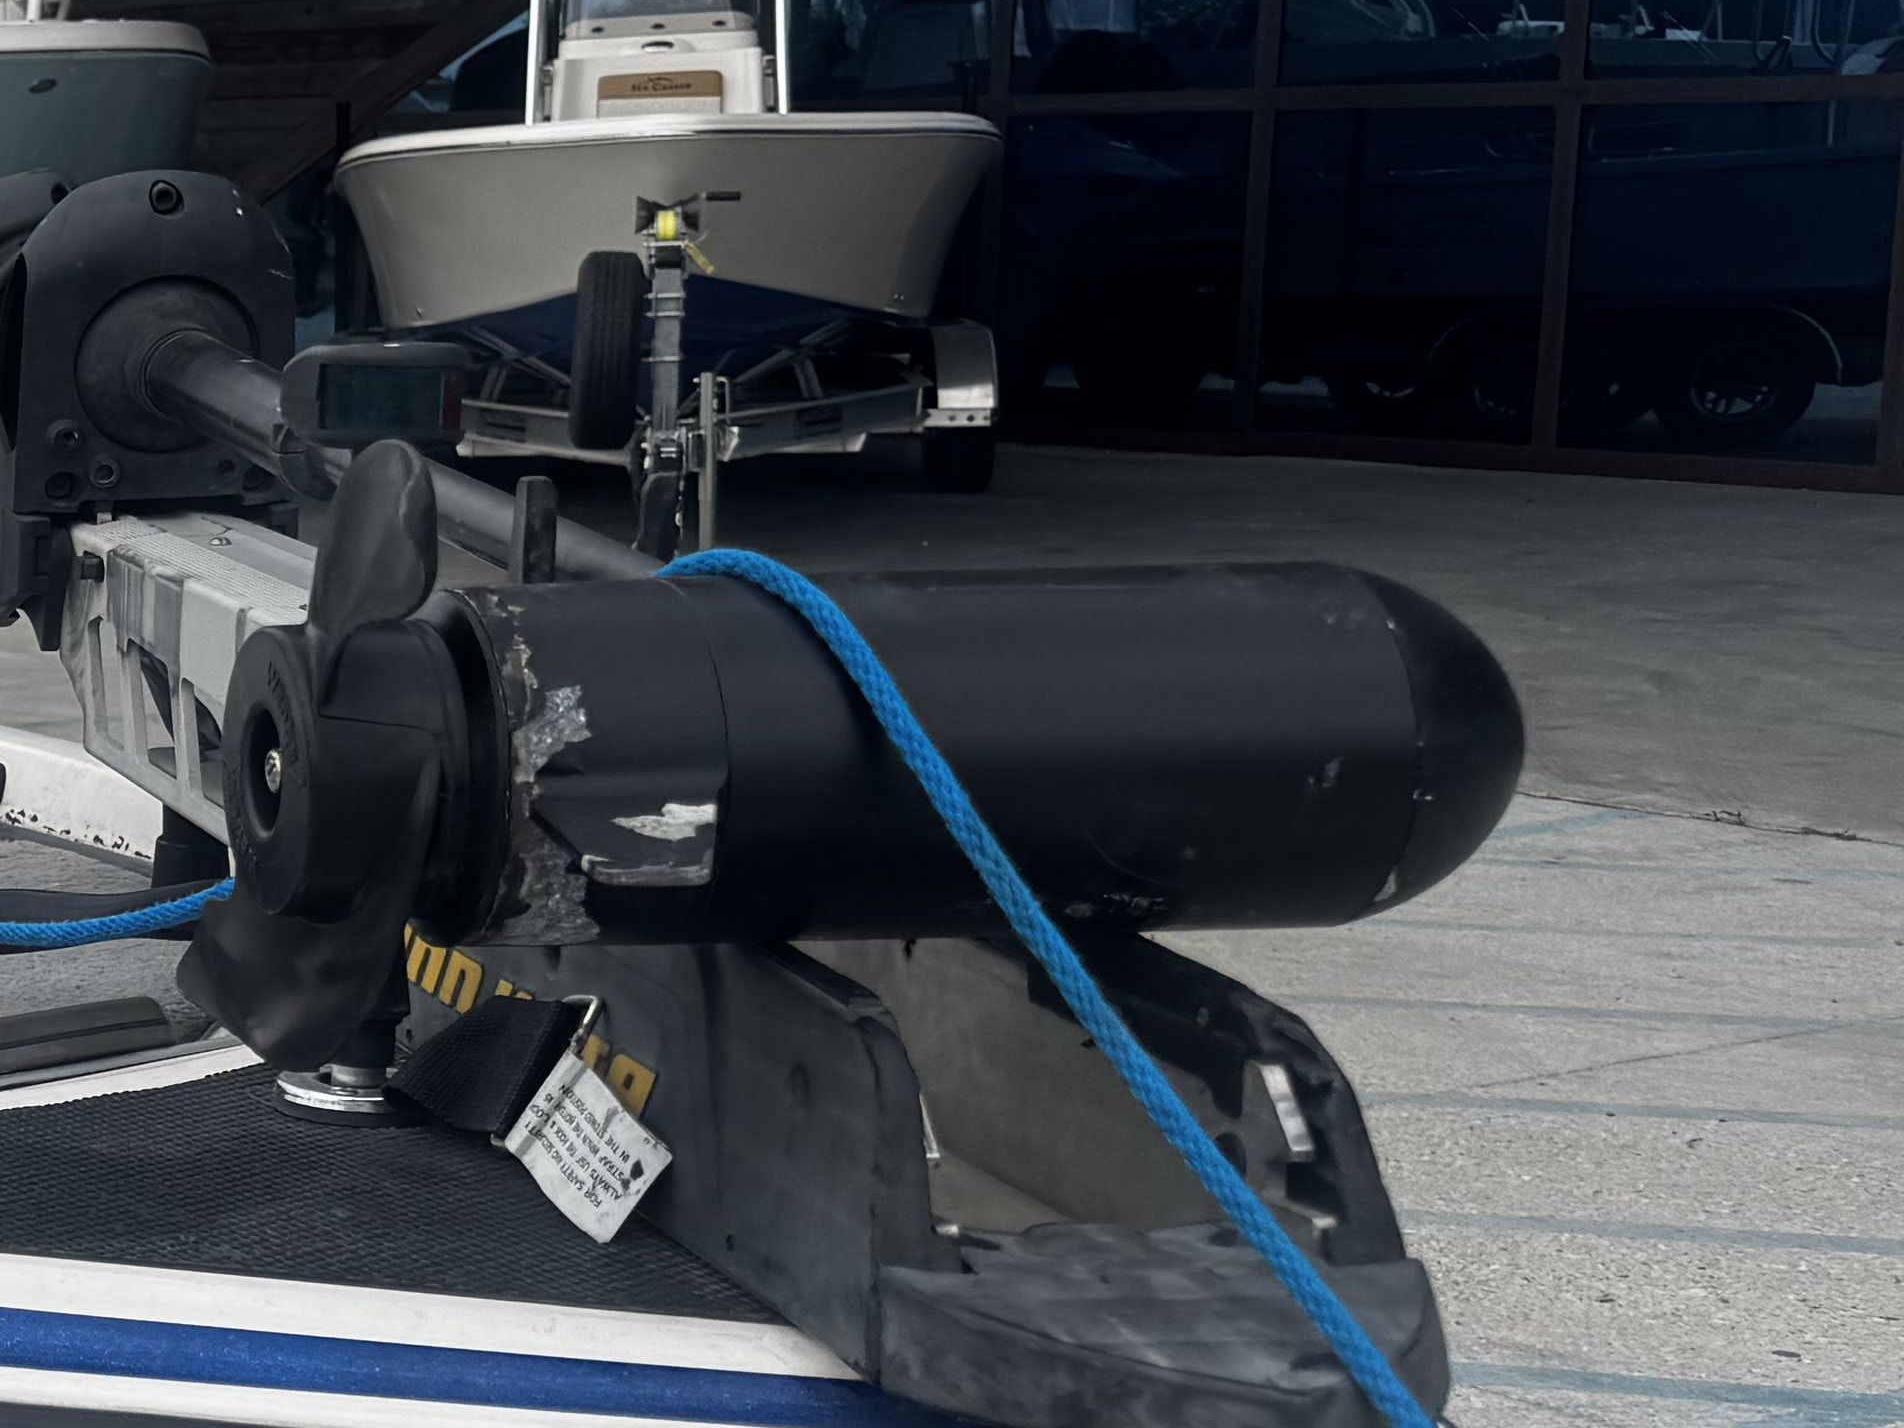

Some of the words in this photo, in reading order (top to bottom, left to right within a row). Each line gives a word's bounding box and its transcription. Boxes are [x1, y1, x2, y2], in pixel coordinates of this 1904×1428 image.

[605, 1136, 620, 1155] THE
[591, 1168, 623, 1201] ALWAYS
[583, 1185, 604, 1209] FOR
